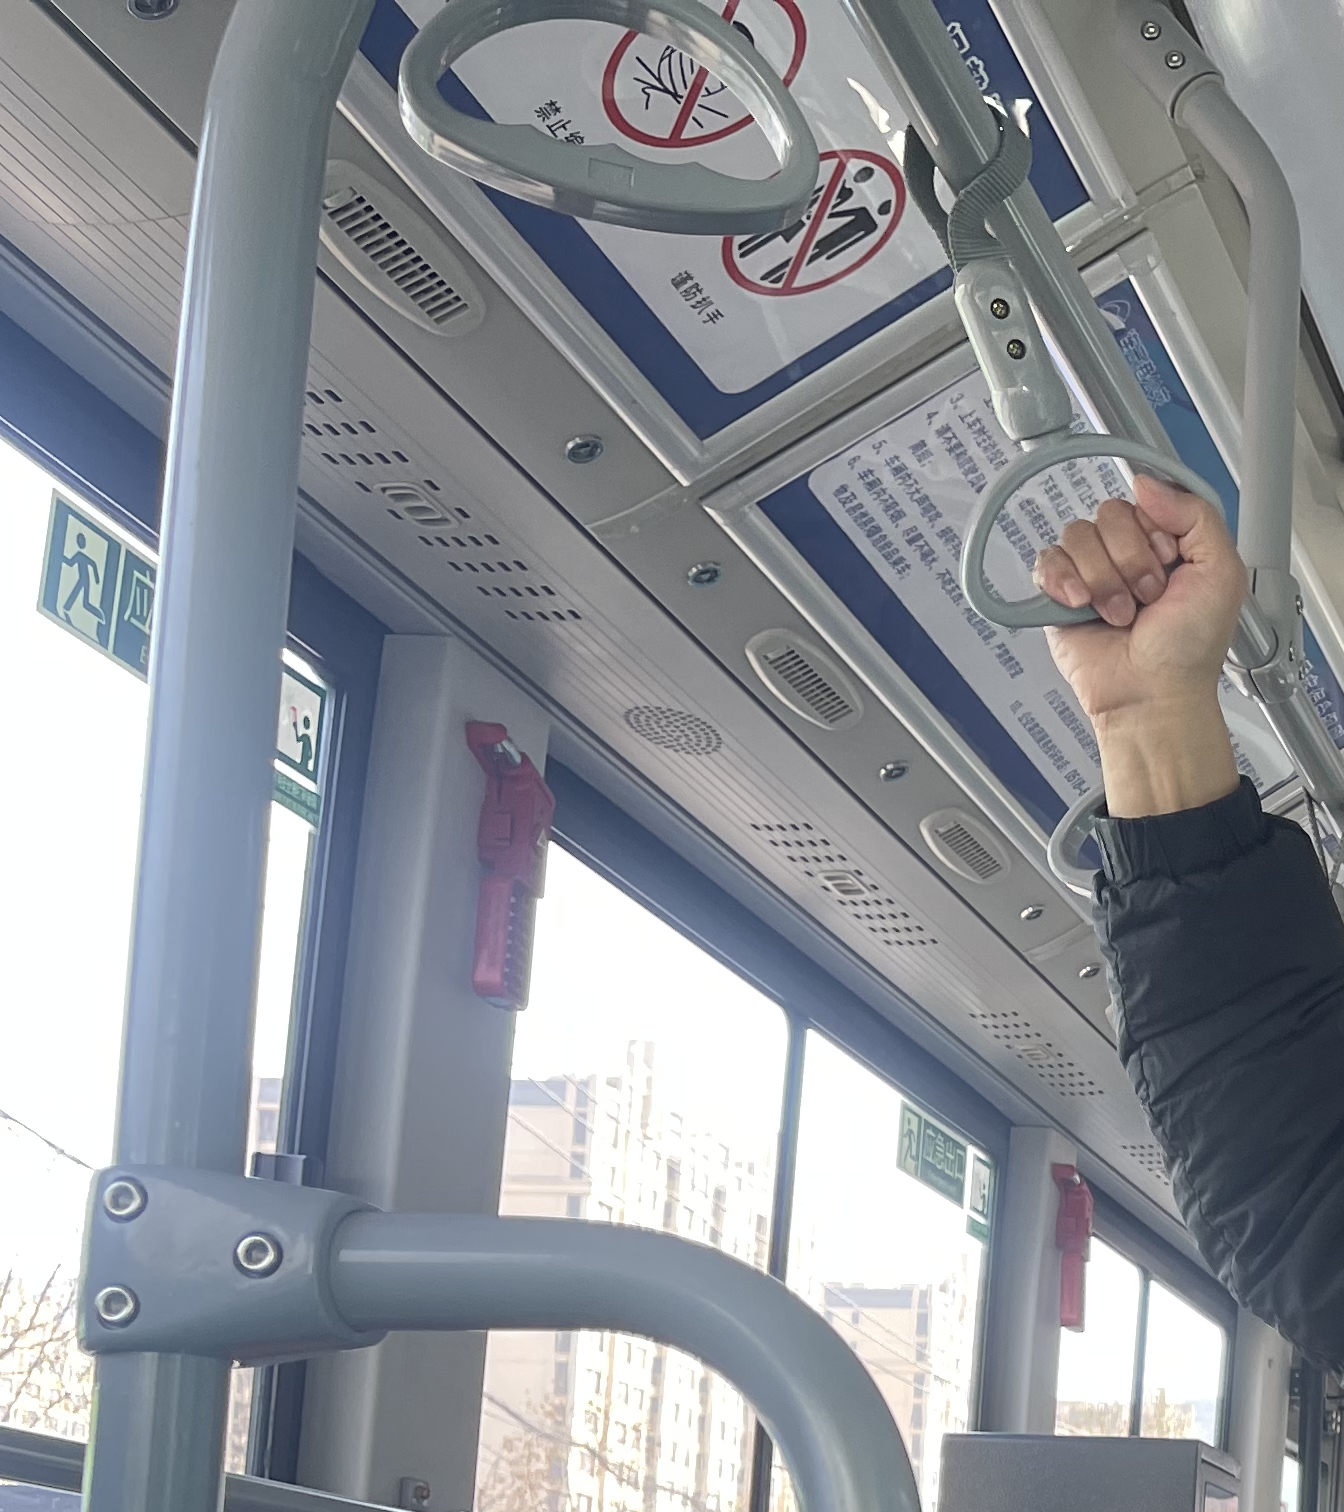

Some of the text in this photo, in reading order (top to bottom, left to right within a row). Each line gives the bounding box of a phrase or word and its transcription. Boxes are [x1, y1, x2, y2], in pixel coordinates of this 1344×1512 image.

[669, 269, 725, 325] 谨防扒手
[923, 1127, 966, 1181] 应急出口
